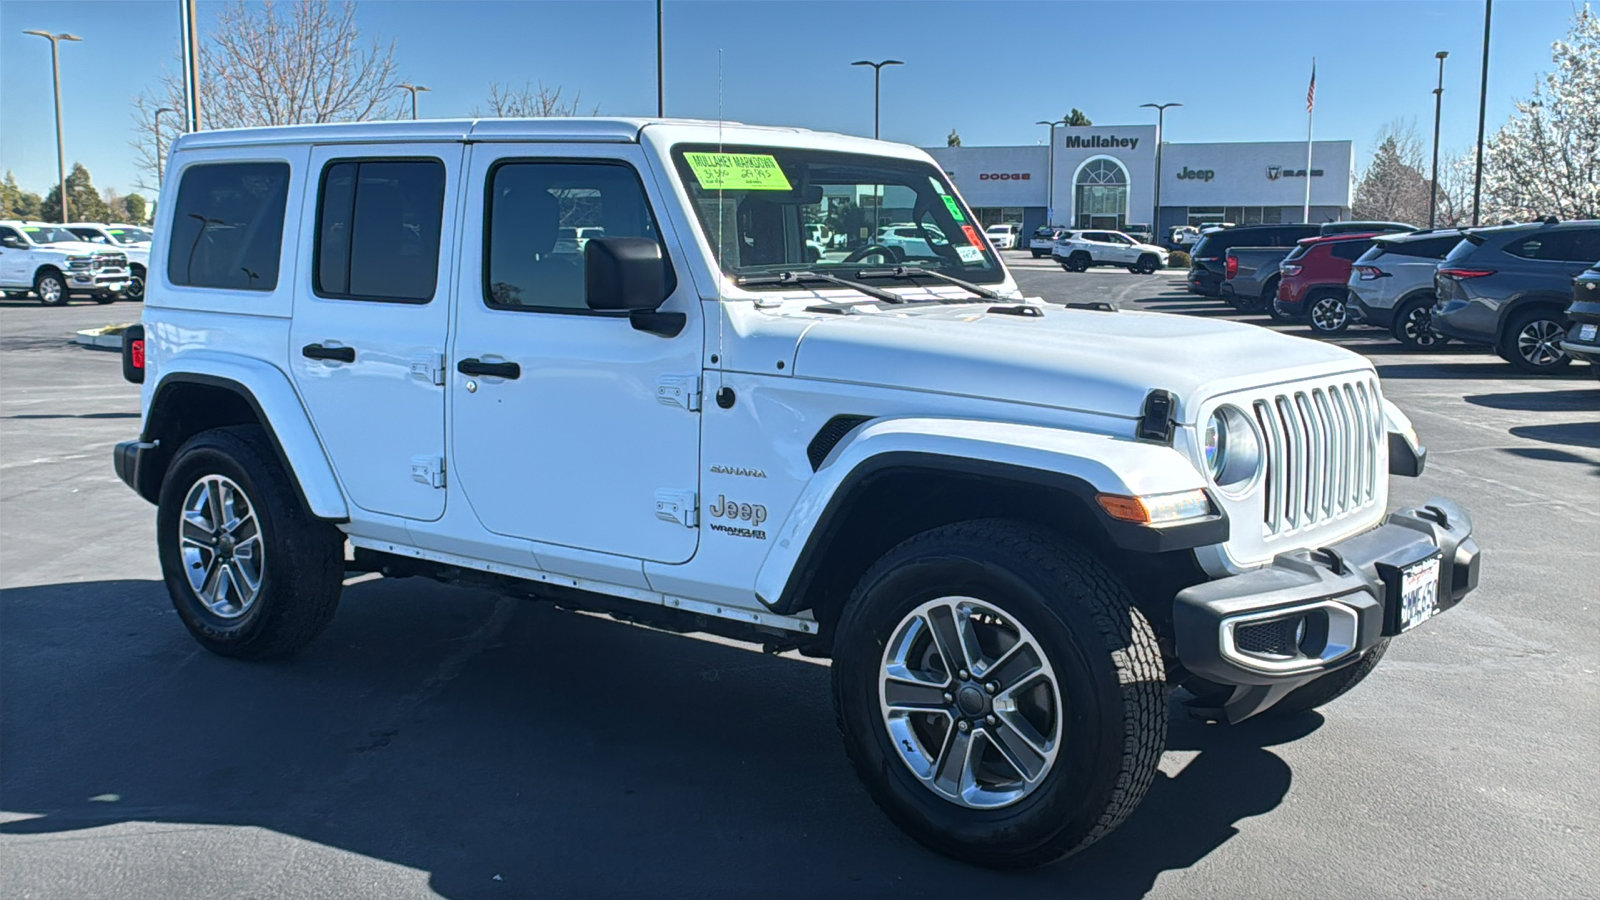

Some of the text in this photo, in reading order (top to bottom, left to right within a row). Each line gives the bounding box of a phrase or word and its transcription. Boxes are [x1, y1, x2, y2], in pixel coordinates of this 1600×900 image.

[1066, 135, 1139, 150] Mullahey
[692, 155, 777, 169] MULLAHEY MARKDOWN
[979, 173, 1031, 181] DODGE
[1177, 166, 1215, 182] Jeep
[709, 465, 767, 478] SAHARA
[709, 494, 767, 527] Jeep
[710, 523, 767, 537] WRANGLER
